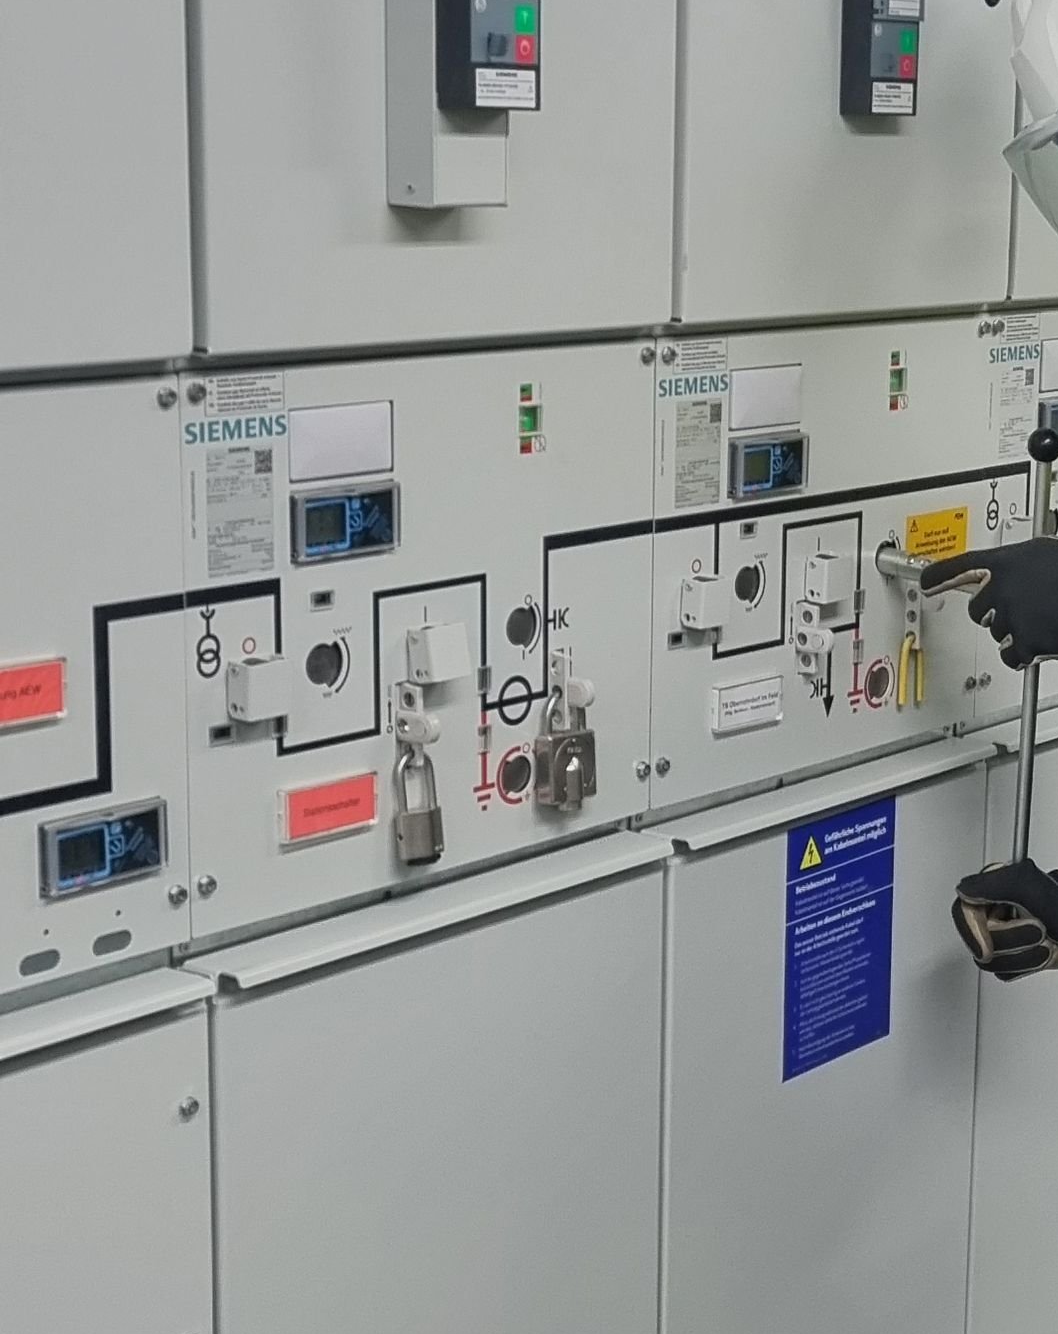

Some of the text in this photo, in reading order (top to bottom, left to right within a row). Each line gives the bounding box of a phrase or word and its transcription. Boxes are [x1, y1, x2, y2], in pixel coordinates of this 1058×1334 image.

[989, 344, 1040, 364] SIEMENS
[658, 374, 729, 398] SIEMENS
[184, 414, 288, 445] SIEMENS
